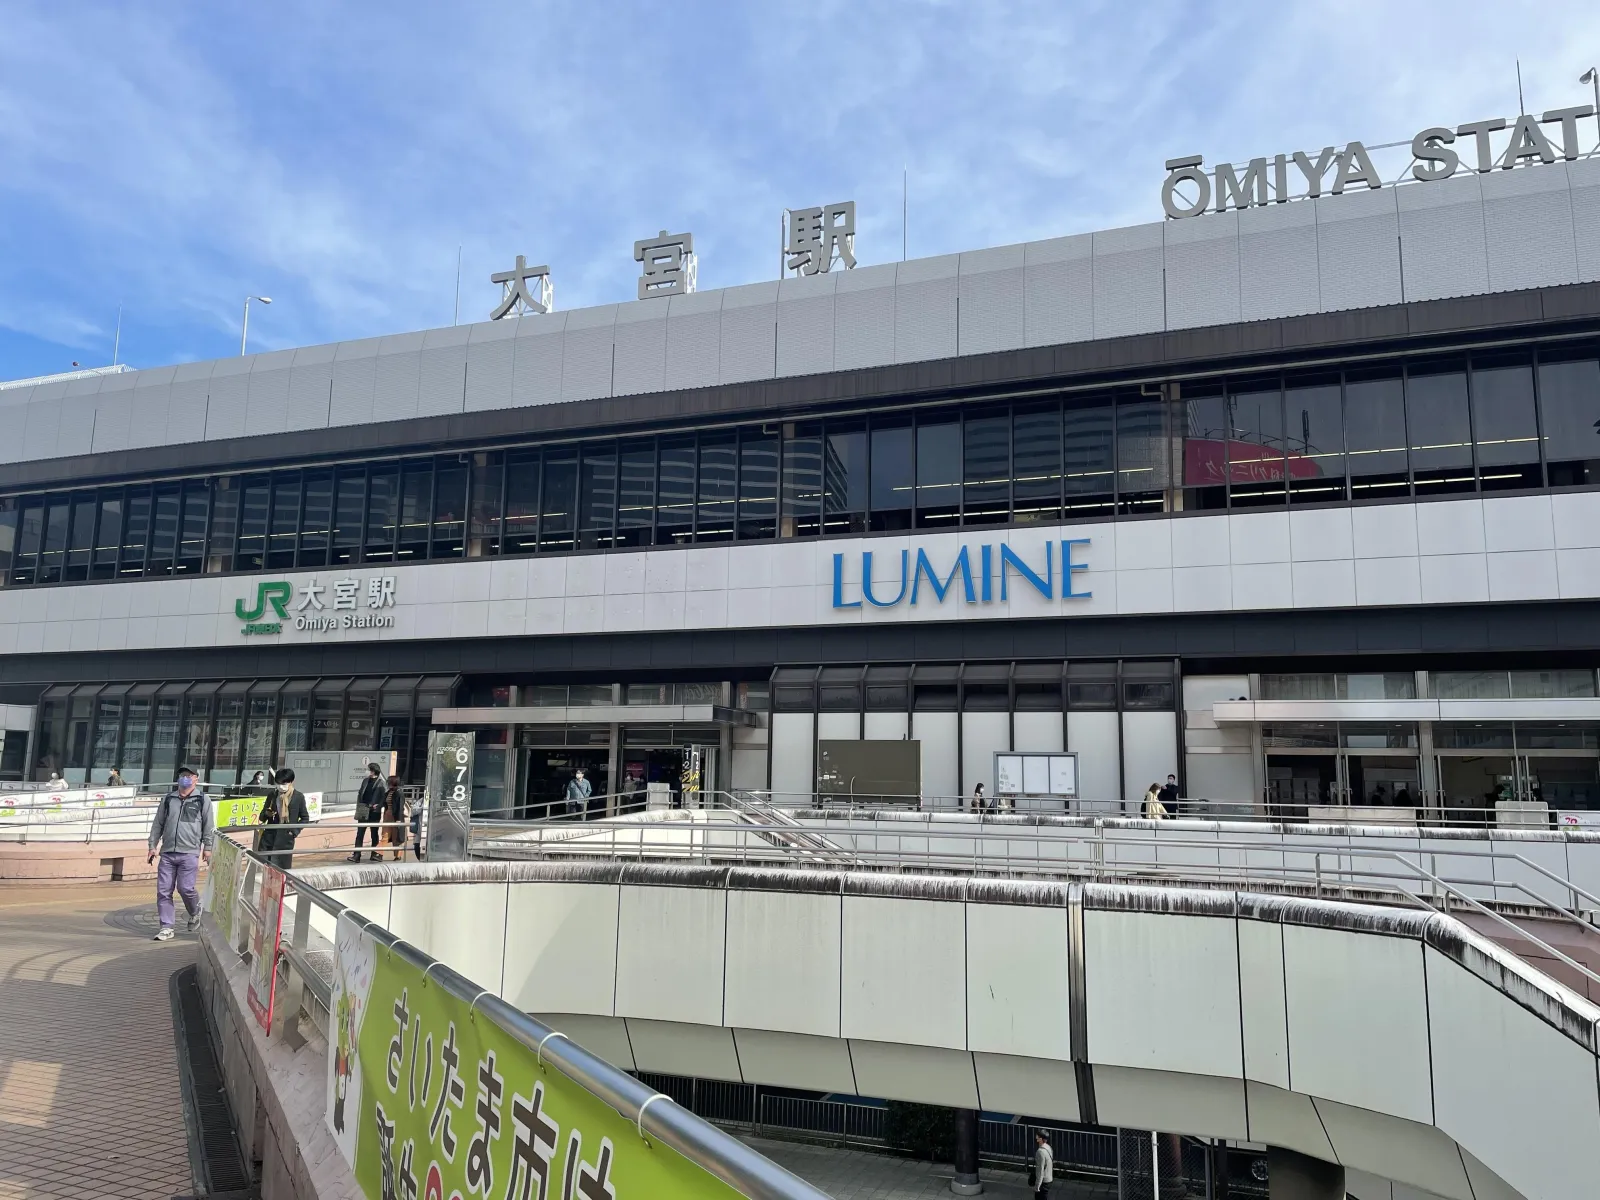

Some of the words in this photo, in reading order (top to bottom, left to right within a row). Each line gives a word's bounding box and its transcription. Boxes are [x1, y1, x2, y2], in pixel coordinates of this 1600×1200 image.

[490, 200, 857, 320] 大宮駅
[833, 538, 1092, 608] LUMINE
[235, 581, 291, 621] JR
[297, 576, 395, 611] 大宮駅
[343, 613, 394, 628] Station
[455, 747, 468, 764] 6
[455, 766, 467, 782] 7
[453, 784, 466, 801] 8
[231, 801, 265, 814] さいた
[229, 812, 261, 827] 誕生2
